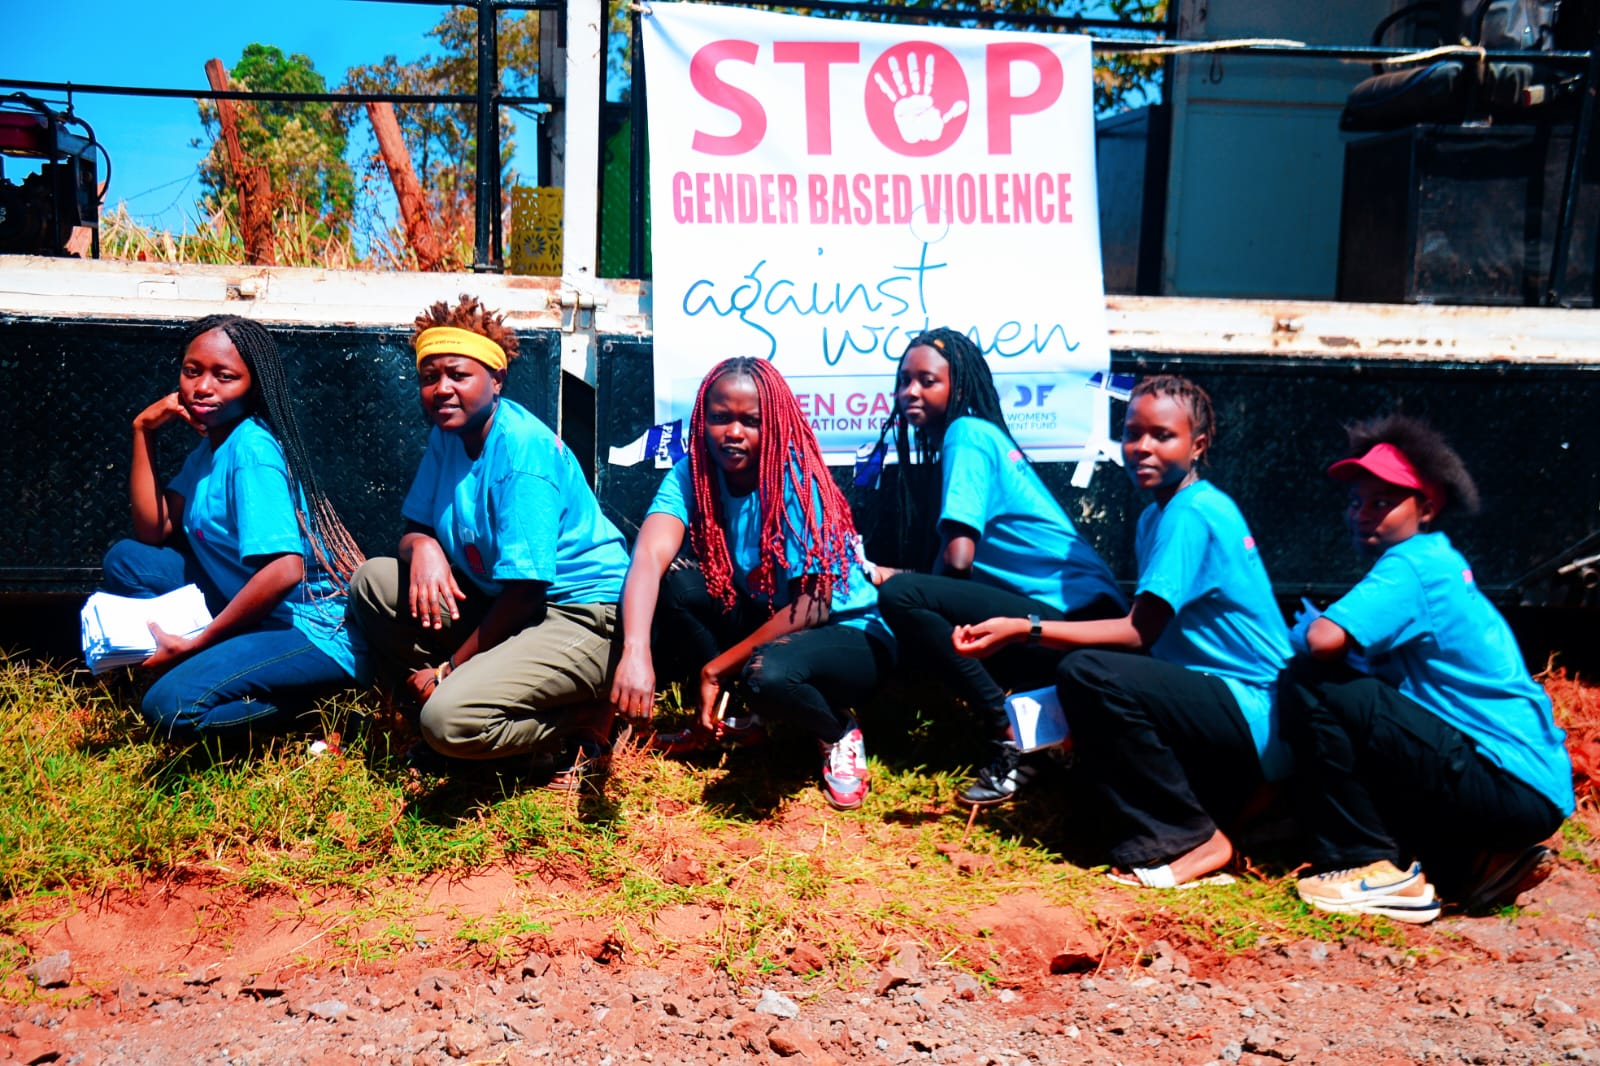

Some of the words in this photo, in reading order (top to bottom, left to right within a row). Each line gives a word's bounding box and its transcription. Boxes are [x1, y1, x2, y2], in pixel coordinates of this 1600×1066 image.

[689, 38, 1064, 158] STOP
[672, 170, 799, 225] GENDER
[808, 172, 912, 226] BASED
[921, 172, 1074, 225] VIOLENCE
[682, 241, 947, 361] against
[794, 392, 835, 417] EN
[810, 418, 862, 431] ATION
